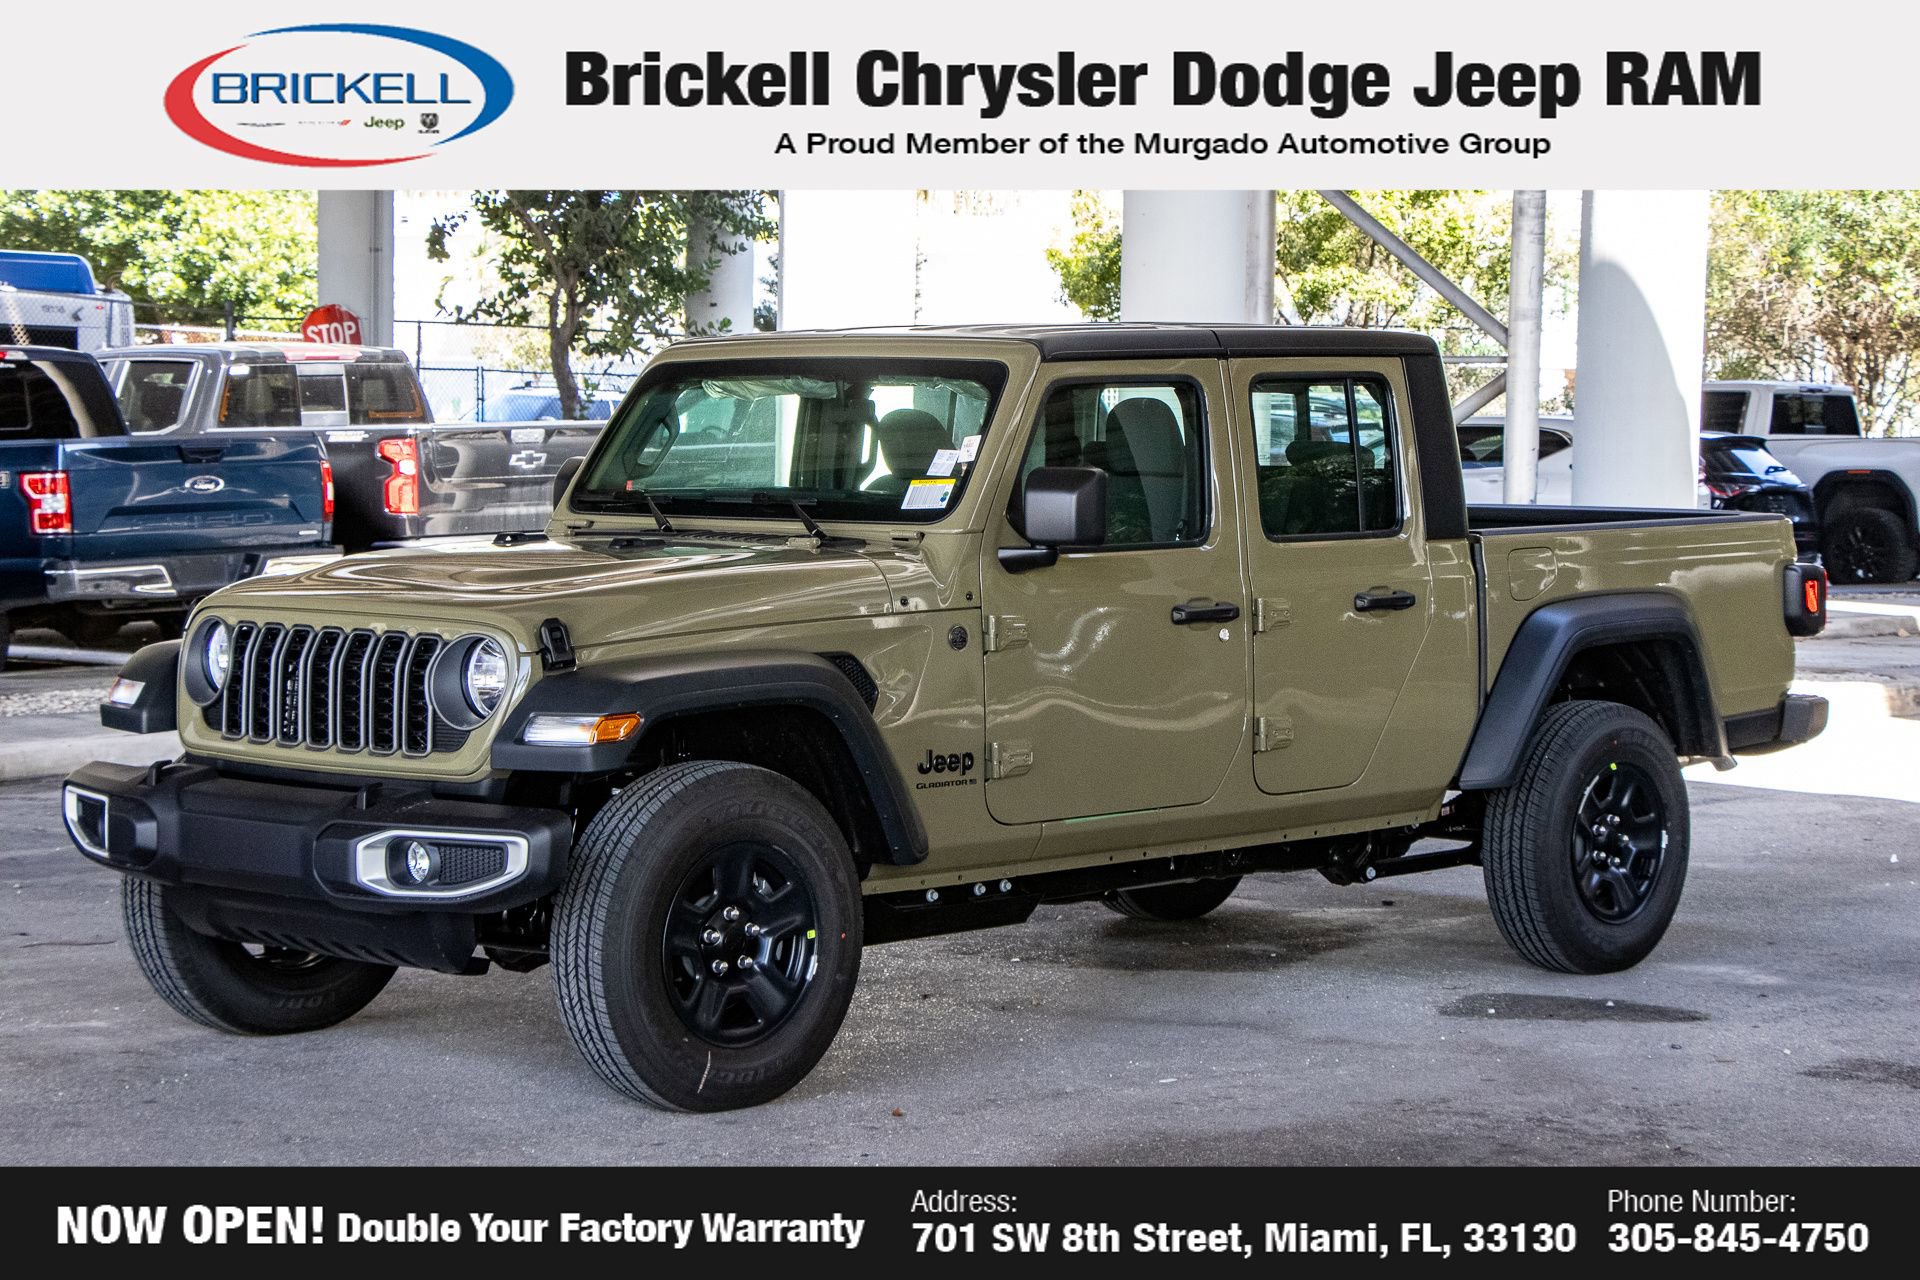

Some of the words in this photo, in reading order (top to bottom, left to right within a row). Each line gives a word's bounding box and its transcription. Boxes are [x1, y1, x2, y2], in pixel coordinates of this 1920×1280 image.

[306, 321, 357, 344] STOP
[917, 749, 974, 776] Jeep
[916, 778, 968, 790] GLADIATOR
